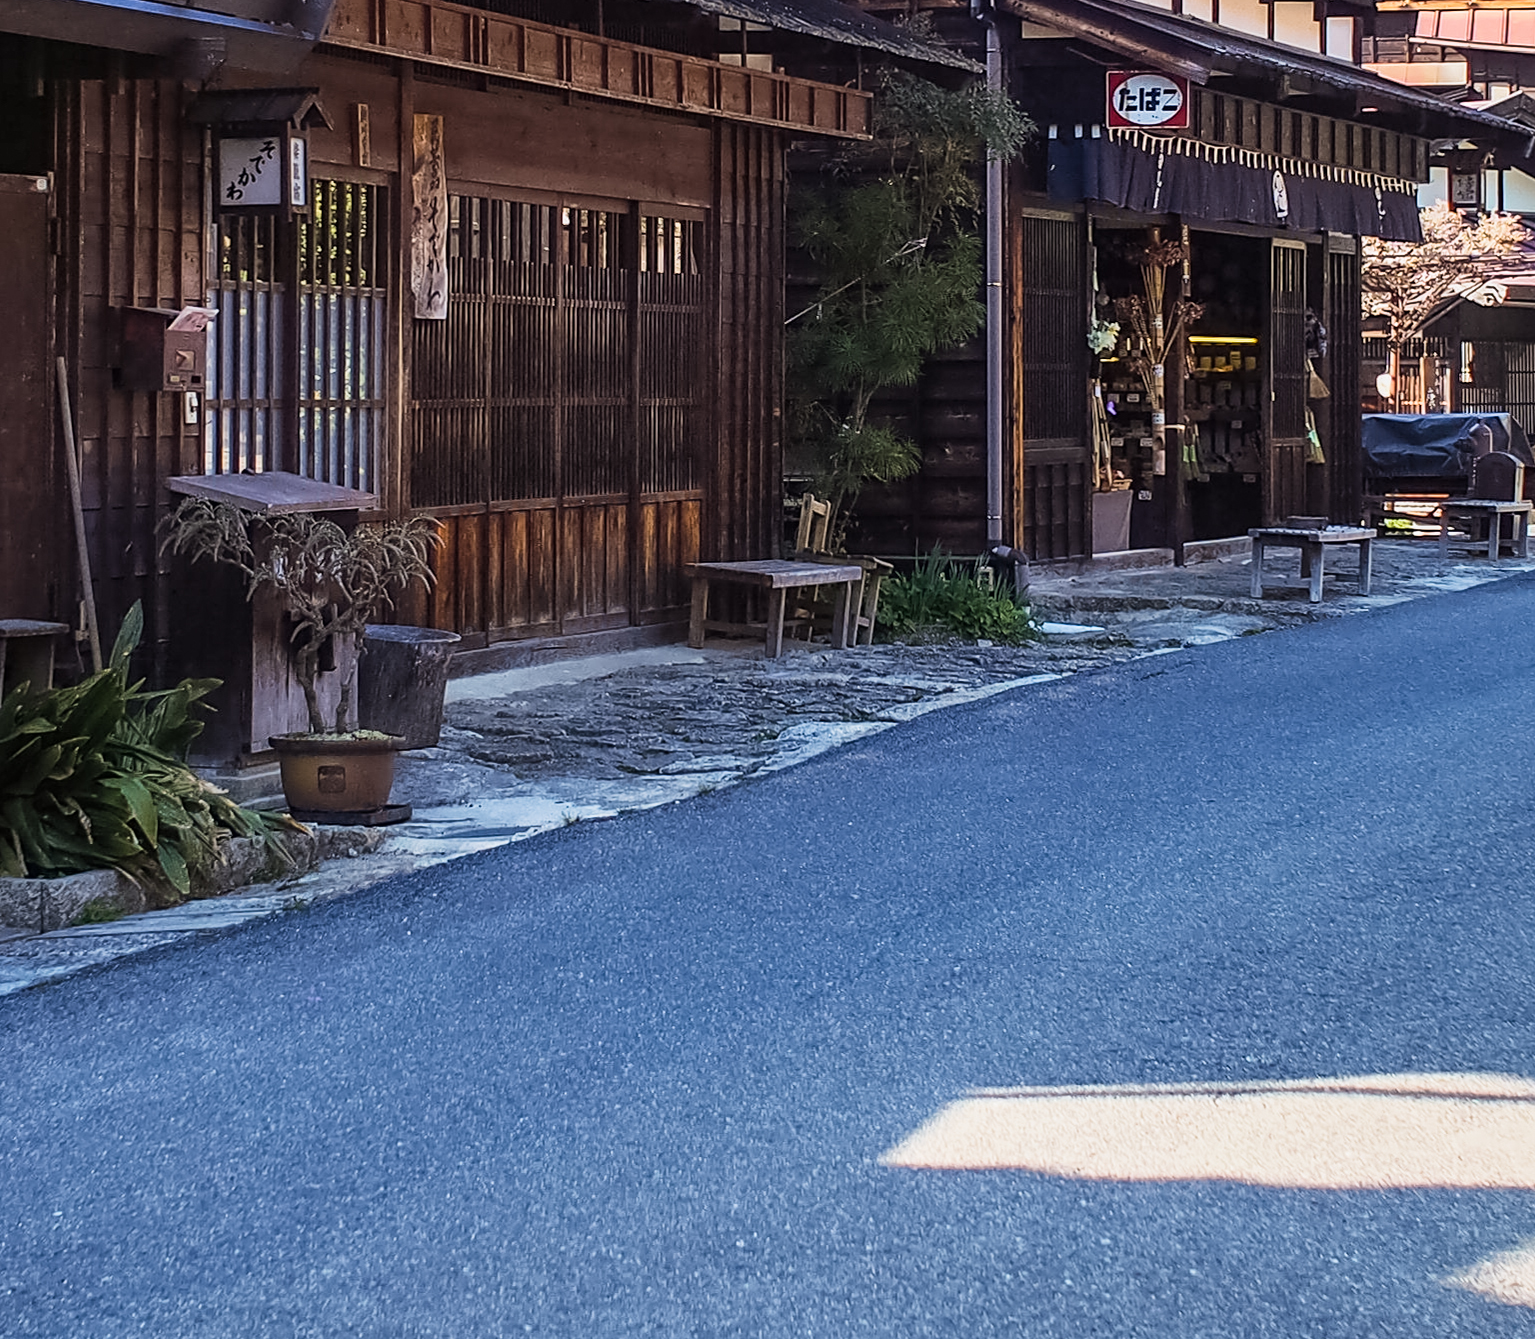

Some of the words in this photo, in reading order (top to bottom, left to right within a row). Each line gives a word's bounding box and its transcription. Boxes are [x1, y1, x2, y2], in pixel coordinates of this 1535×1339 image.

[1118, 87, 1178, 112] たばこ
[226, 140, 276, 201] そでかわ
